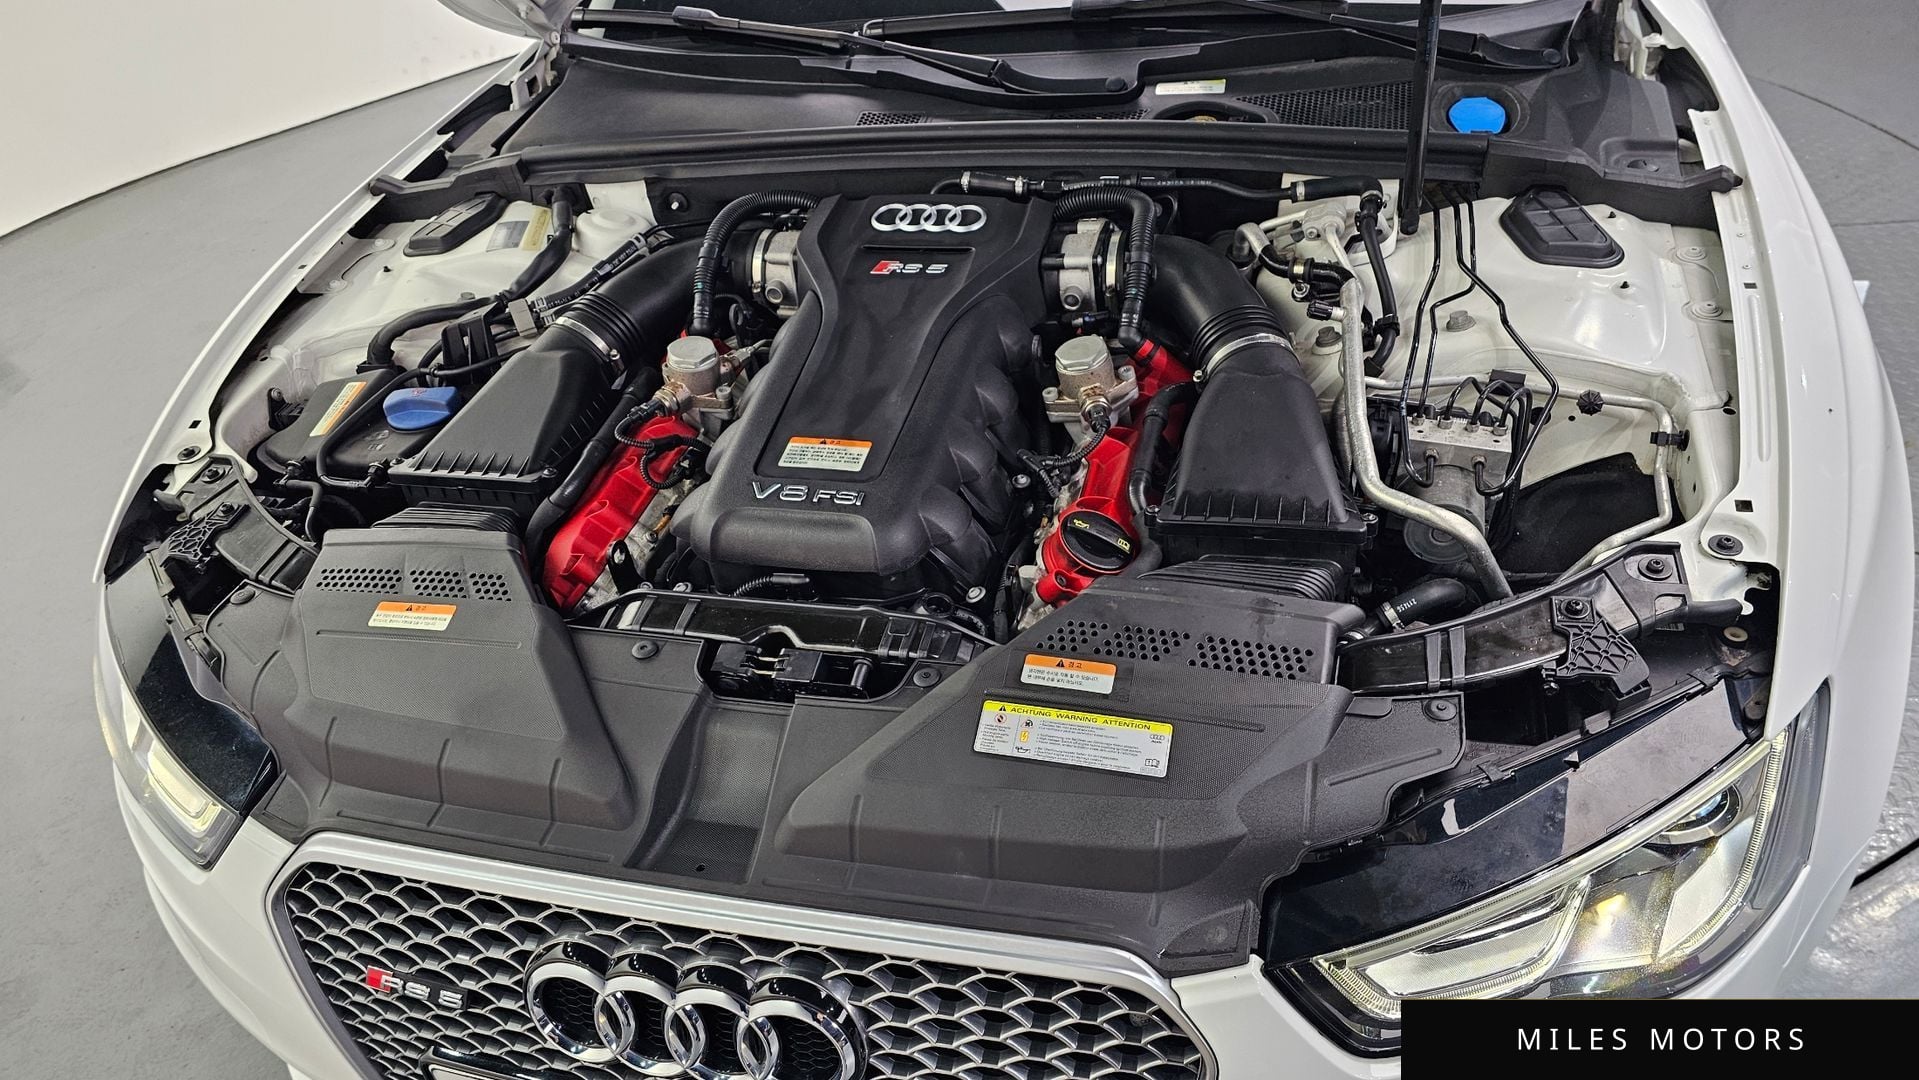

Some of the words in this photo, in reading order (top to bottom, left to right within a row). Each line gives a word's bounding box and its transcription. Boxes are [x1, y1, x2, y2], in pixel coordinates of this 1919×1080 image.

[752, 481, 809, 502] V8
[812, 489, 865, 506] FSI
[1010, 707, 1051, 717] ACHTUNG
[1056, 713, 1098, 724] WARNING
[1102, 719, 1151, 730] ATTENTION
